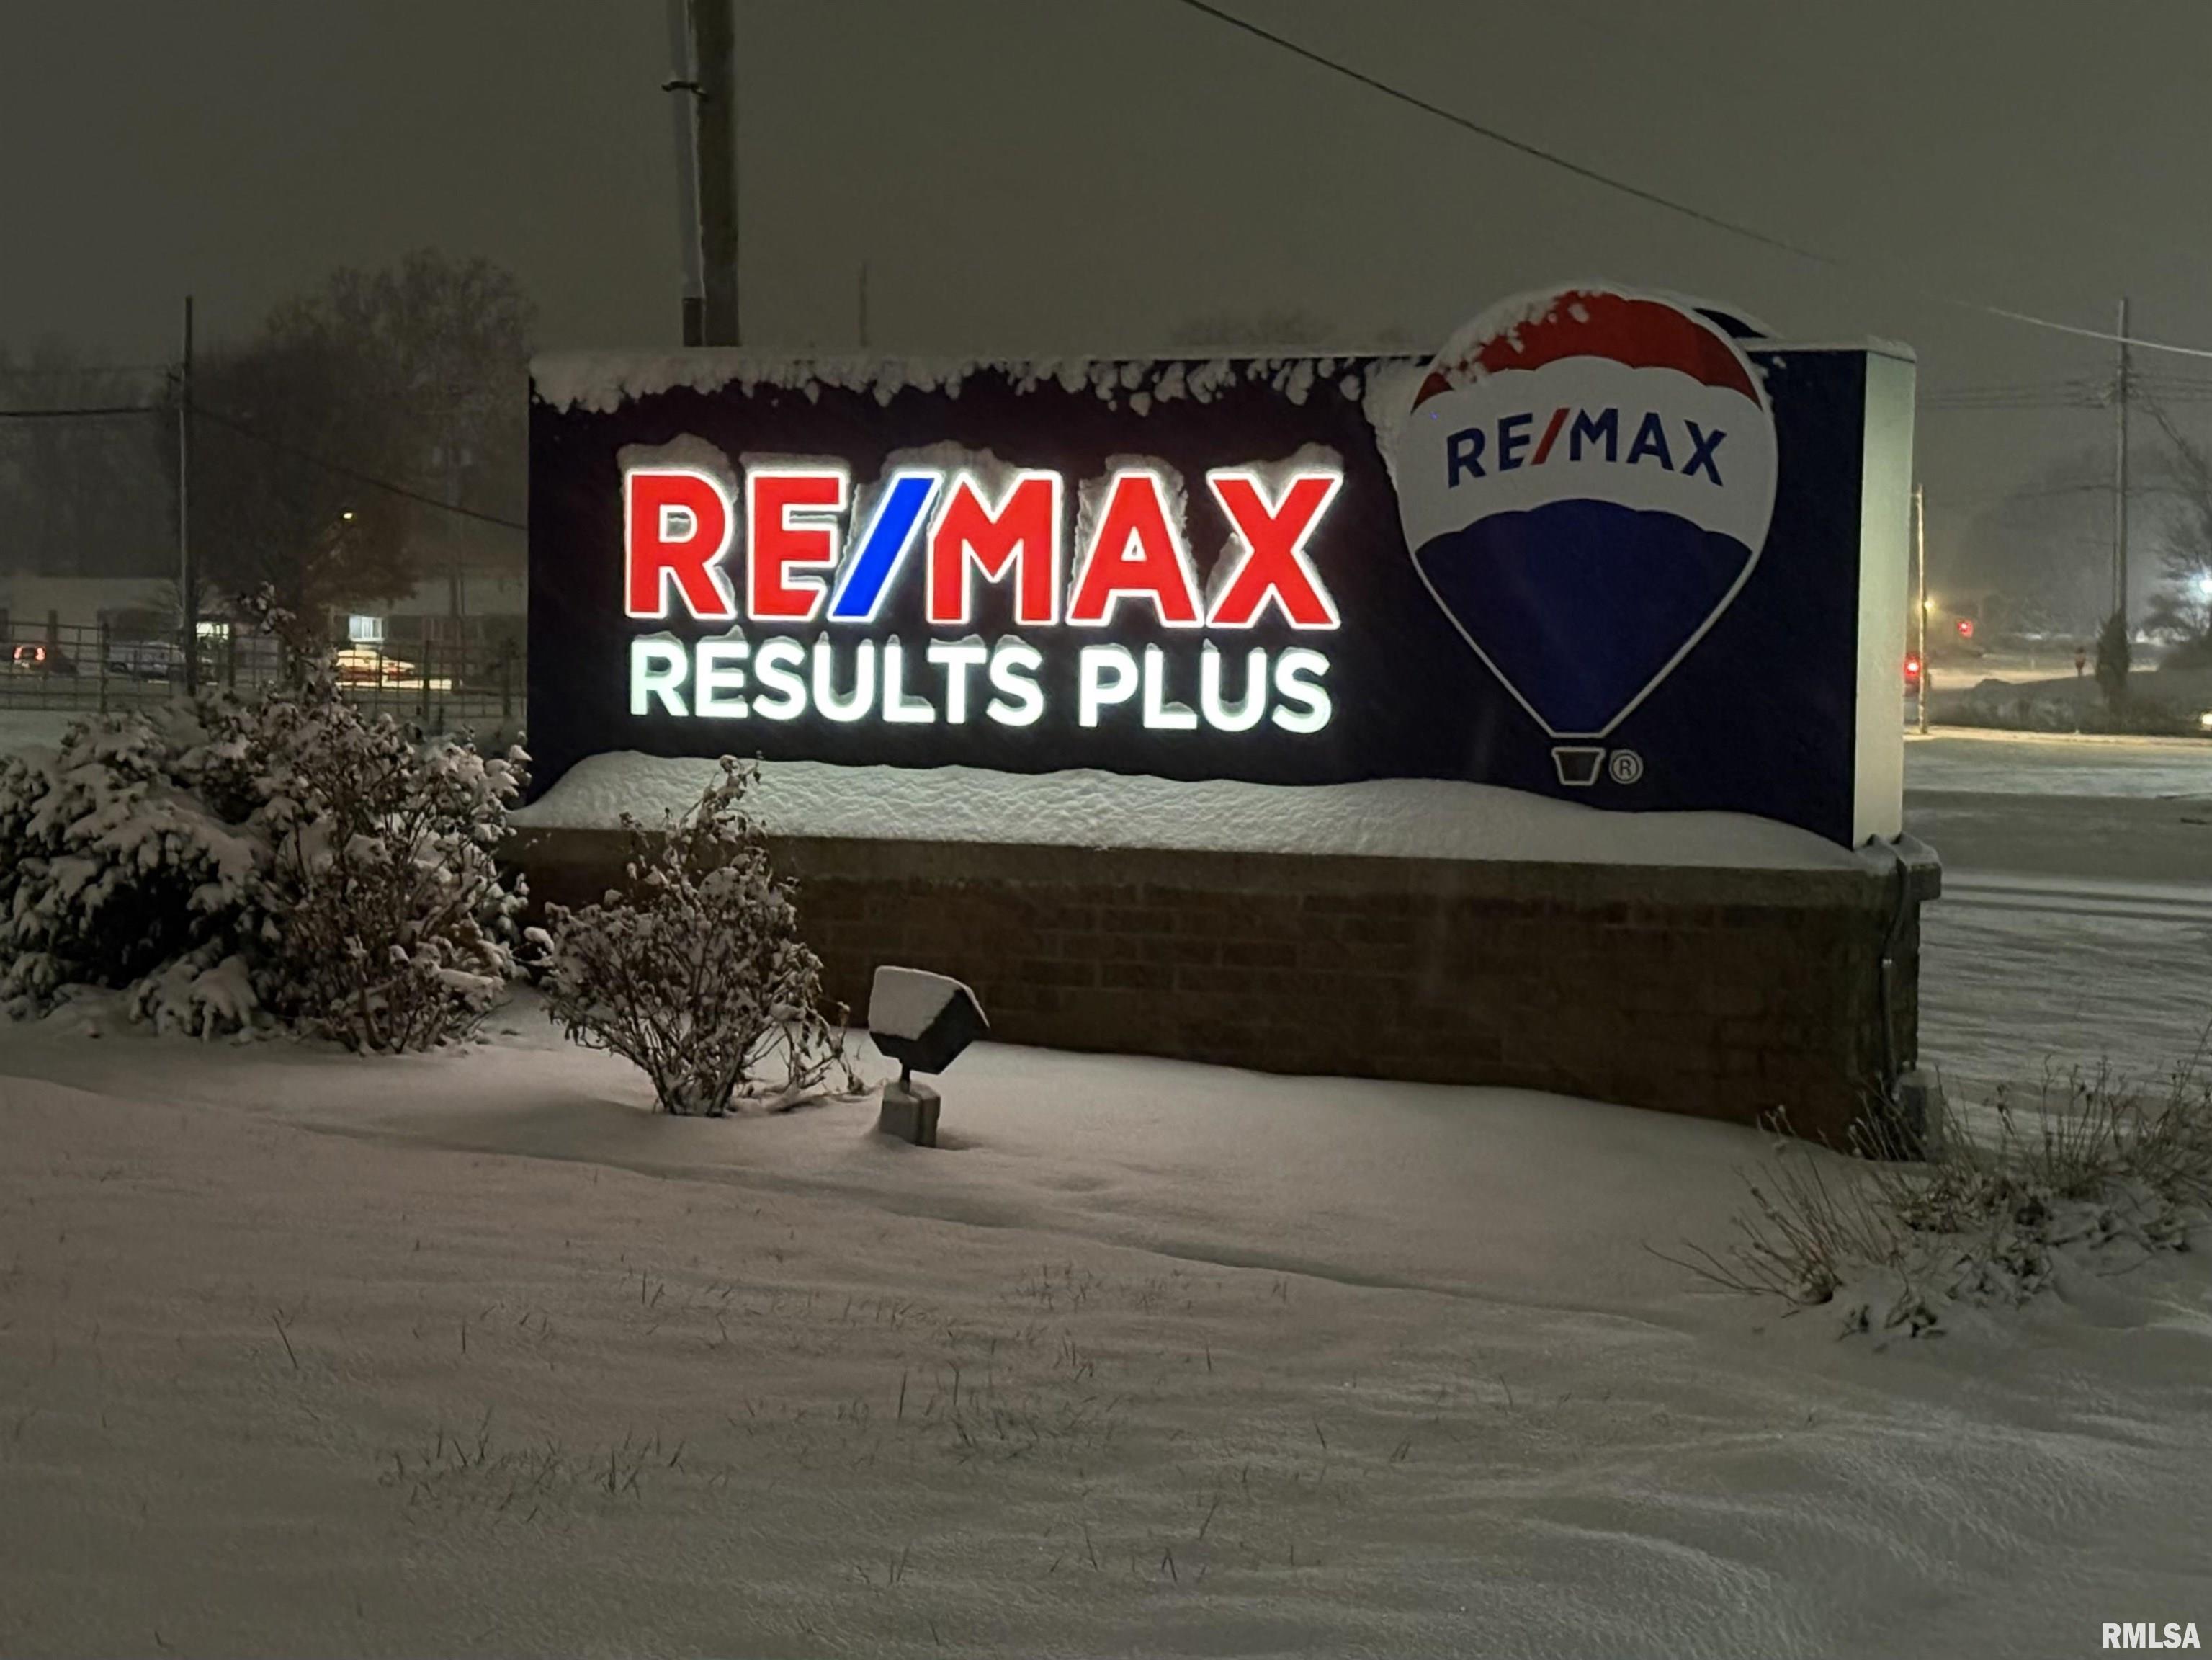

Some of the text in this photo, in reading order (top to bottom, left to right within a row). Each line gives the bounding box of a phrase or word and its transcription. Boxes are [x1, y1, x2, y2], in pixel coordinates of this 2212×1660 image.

[1446, 407, 1727, 488] RE/MAX
[624, 470, 1343, 629] RE/MAX
[630, 639, 1332, 733] RESULTS PLUS
